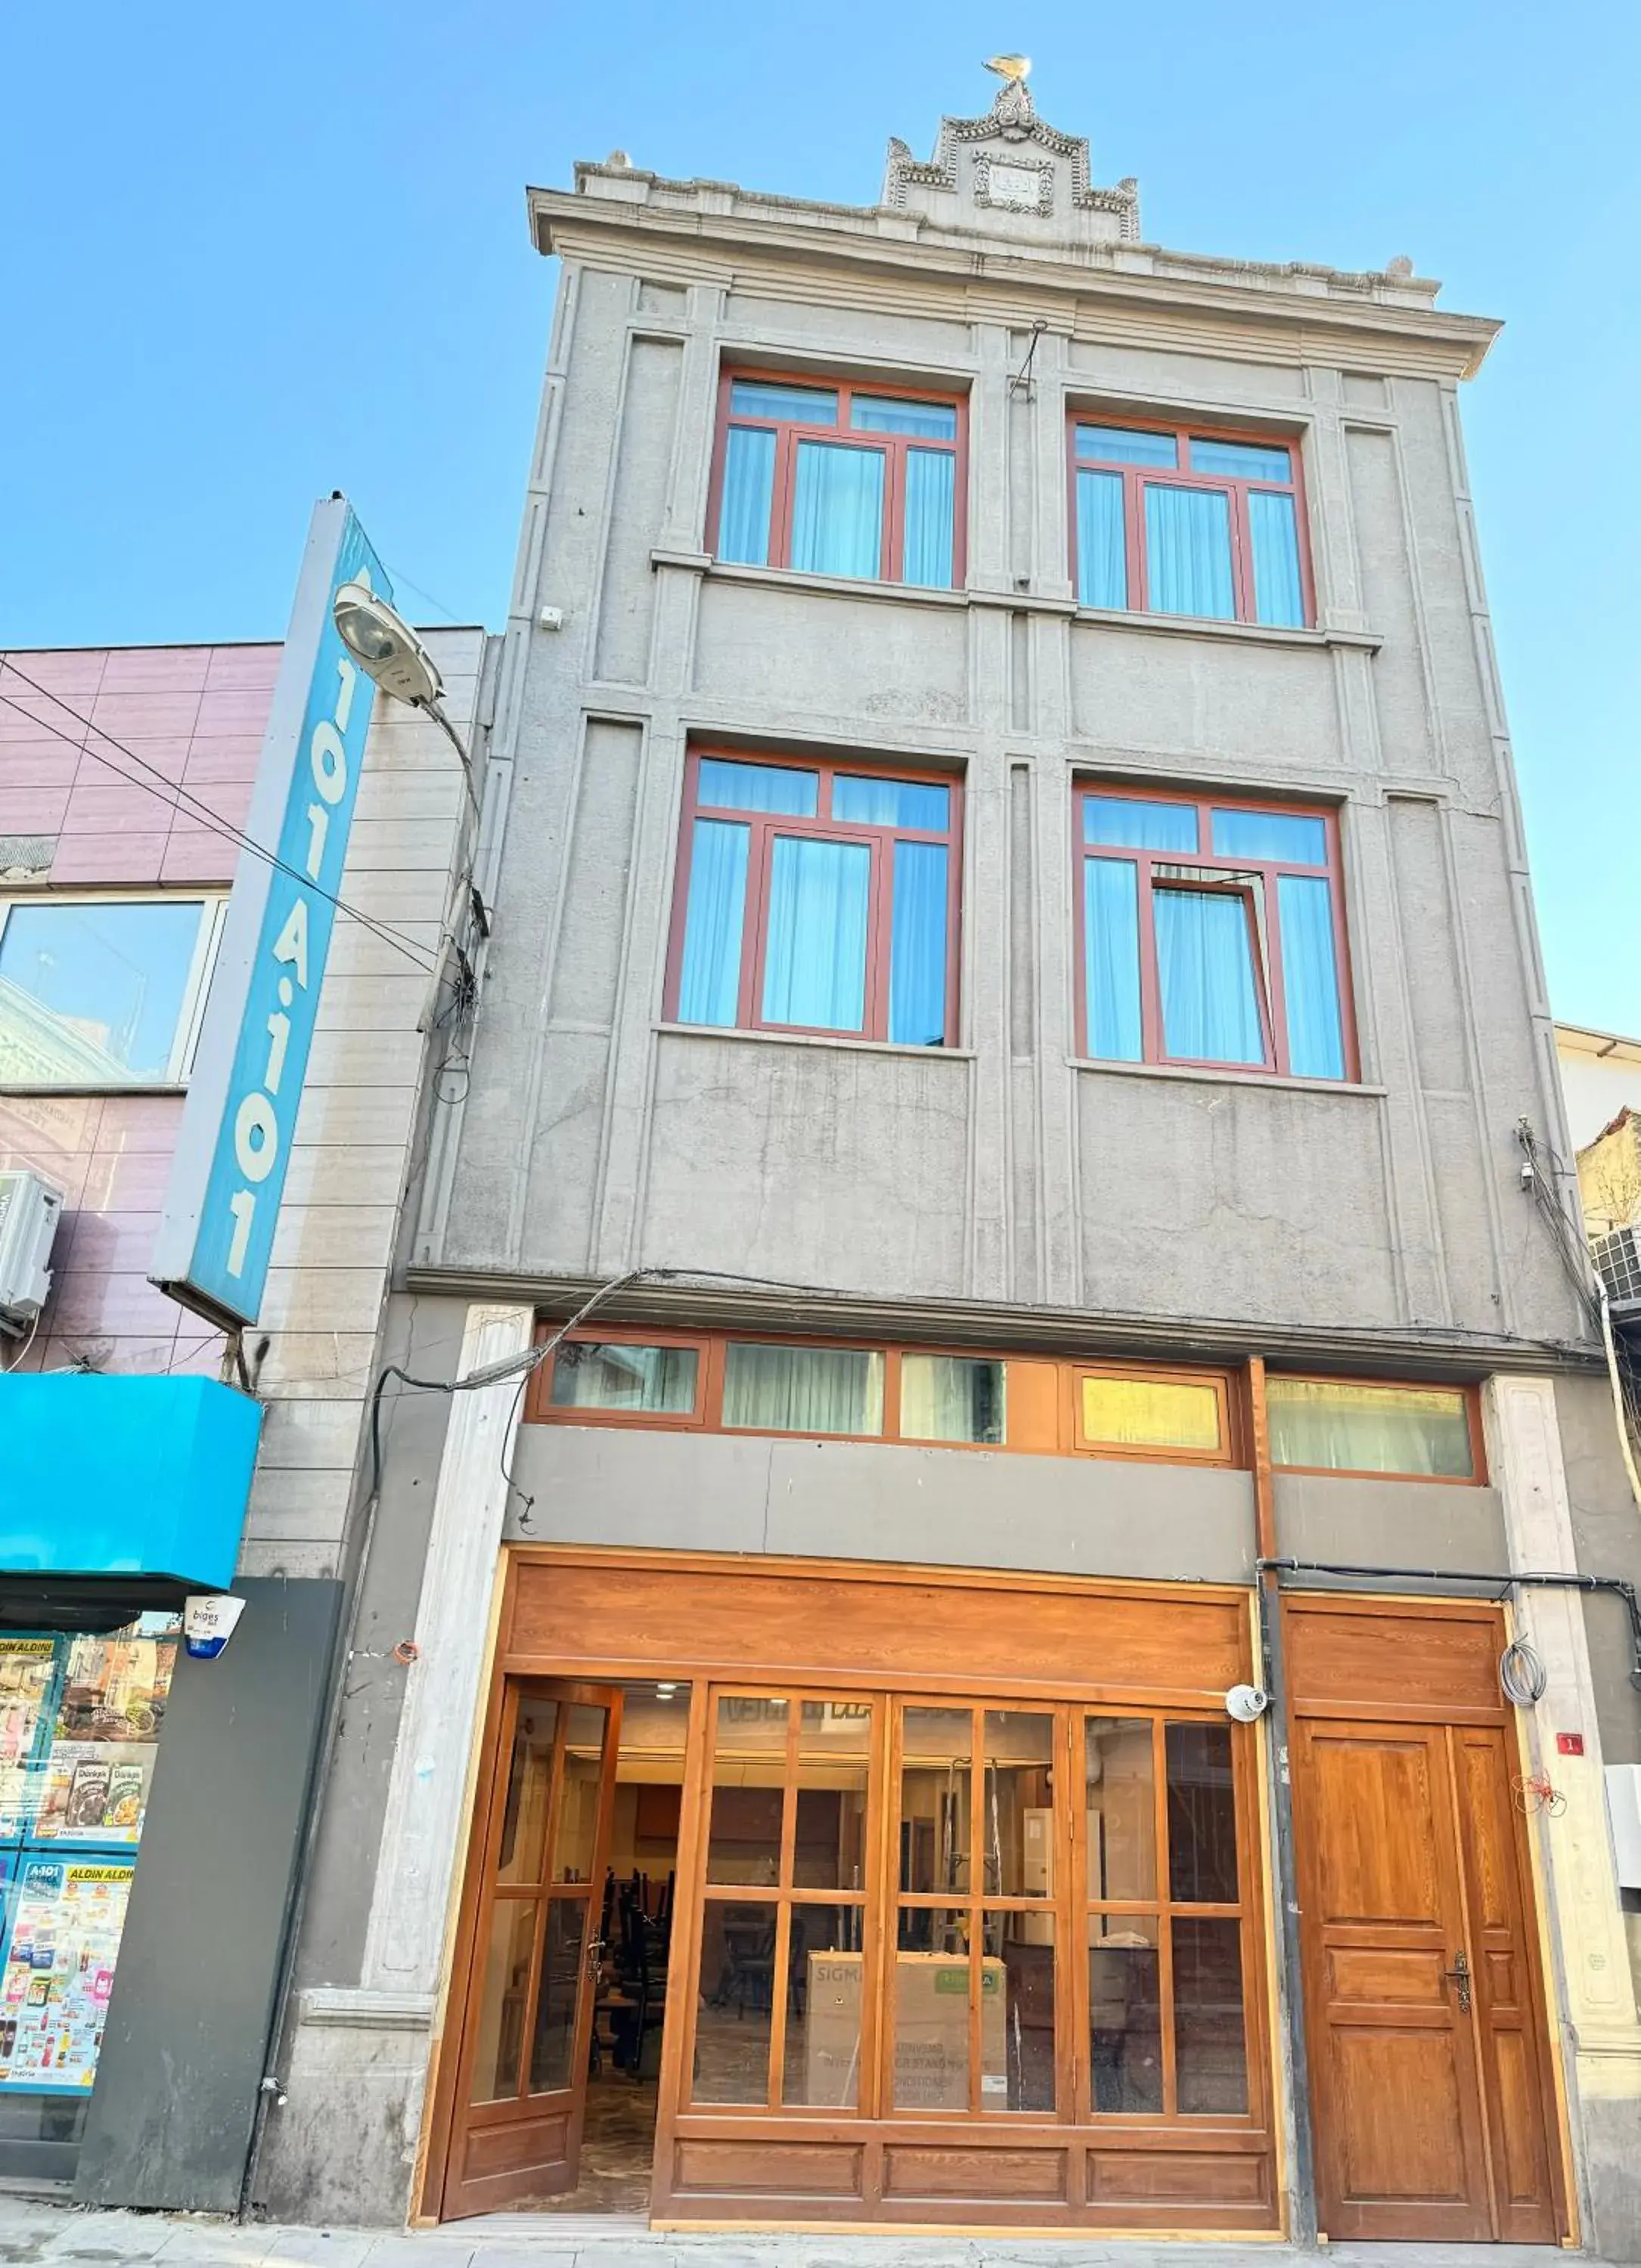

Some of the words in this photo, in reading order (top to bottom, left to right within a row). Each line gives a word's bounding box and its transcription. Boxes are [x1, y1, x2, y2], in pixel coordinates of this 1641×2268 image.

[1566, 1738, 1574, 1750] 1
[70, 1869, 104, 1879] ALDIN
[816, 1966, 863, 1984] SIGM
